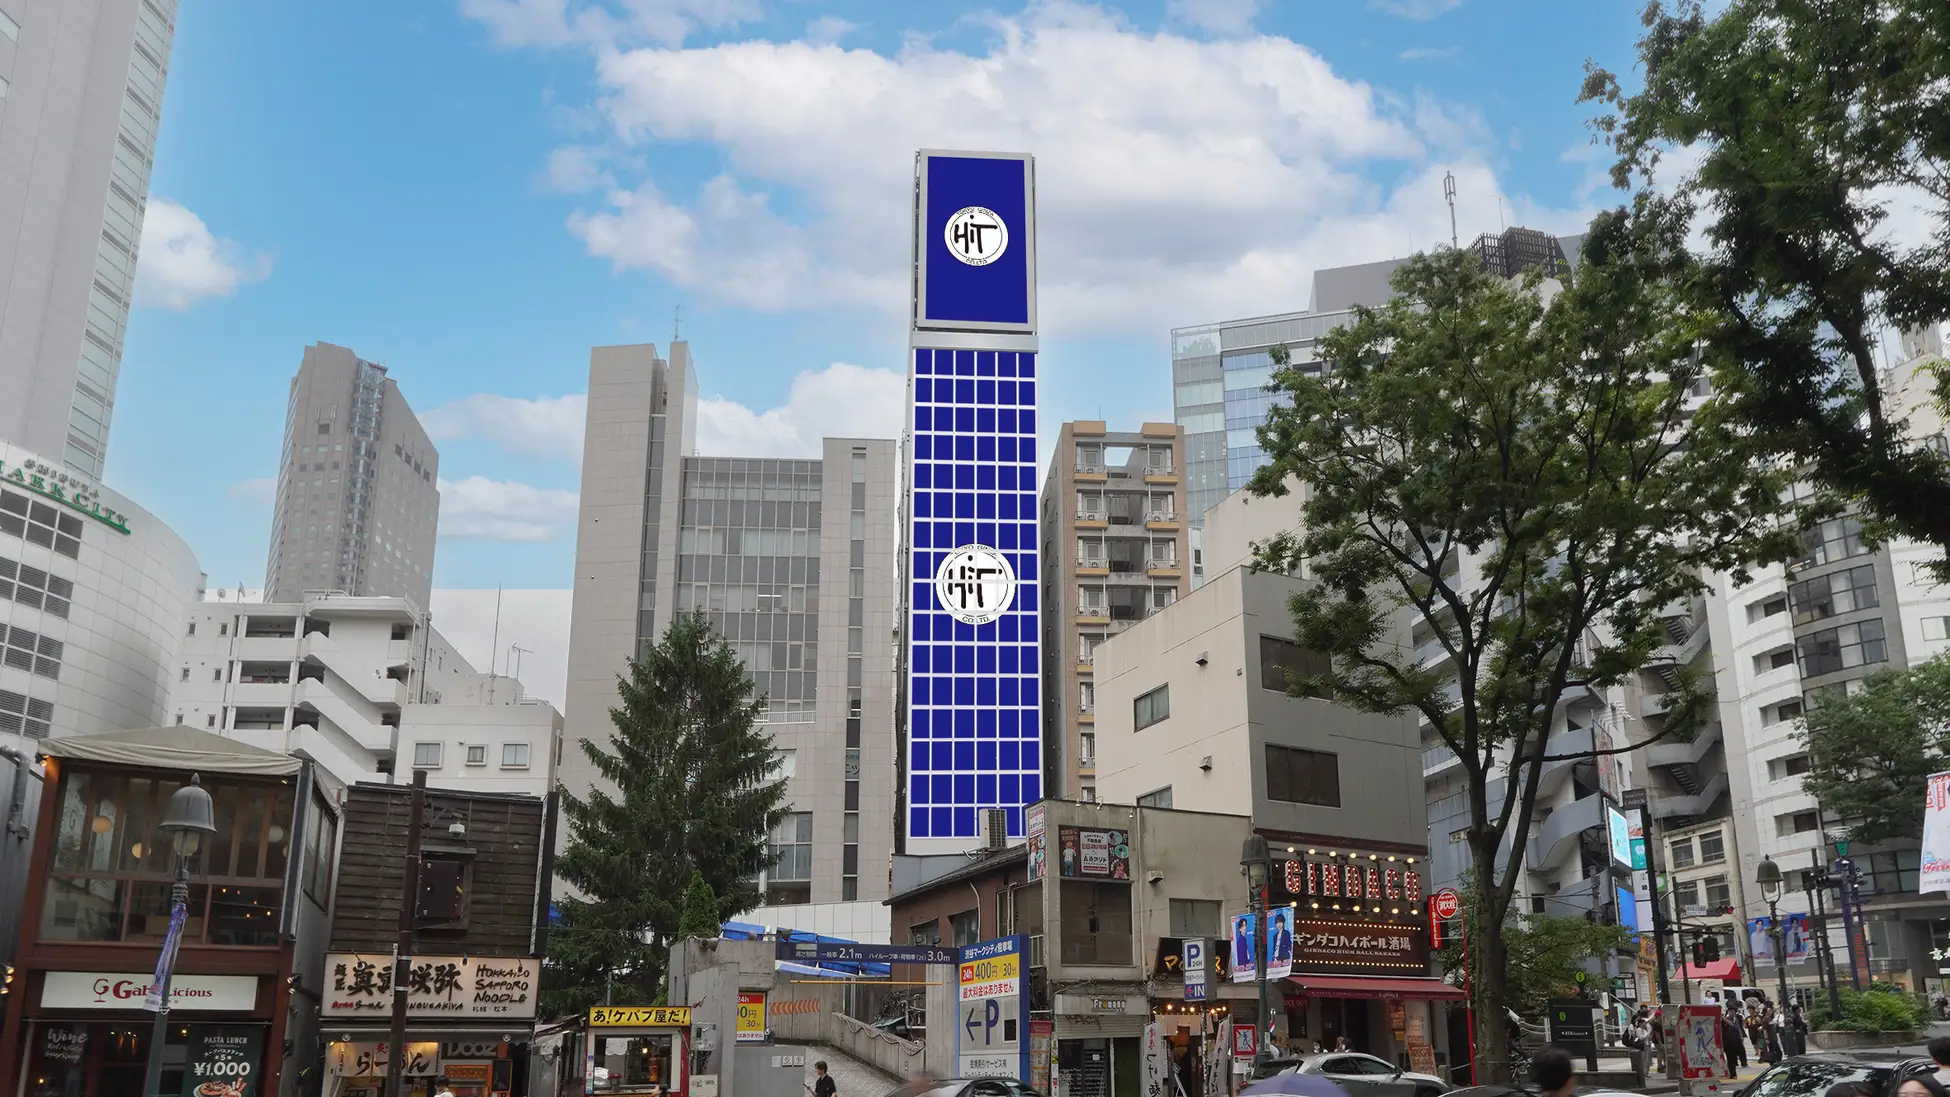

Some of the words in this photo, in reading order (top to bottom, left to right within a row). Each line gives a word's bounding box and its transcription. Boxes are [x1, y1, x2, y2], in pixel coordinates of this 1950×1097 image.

[0, 460, 65, 498] ARK
[72, 492, 128, 527] CITY
[1286, 859, 1421, 902] GINDACO
[1293, 932, 1411, 951] ギンダコハイボール酒場
[839, 947, 863, 959] 2.1m
[927, 950, 951, 962] 3.0m
[1187, 944, 1201, 968] P
[475, 979, 528, 991] SAPPORO
[963, 982, 1015, 998] 最大料金はありません
[1194, 985, 1205, 997] IN
[474, 991, 527, 1003] NOODLE
[986, 999, 999, 1045] P
[48, 1028, 88, 1044] Wine
[194, 1062, 250, 1077] ¥1,000
